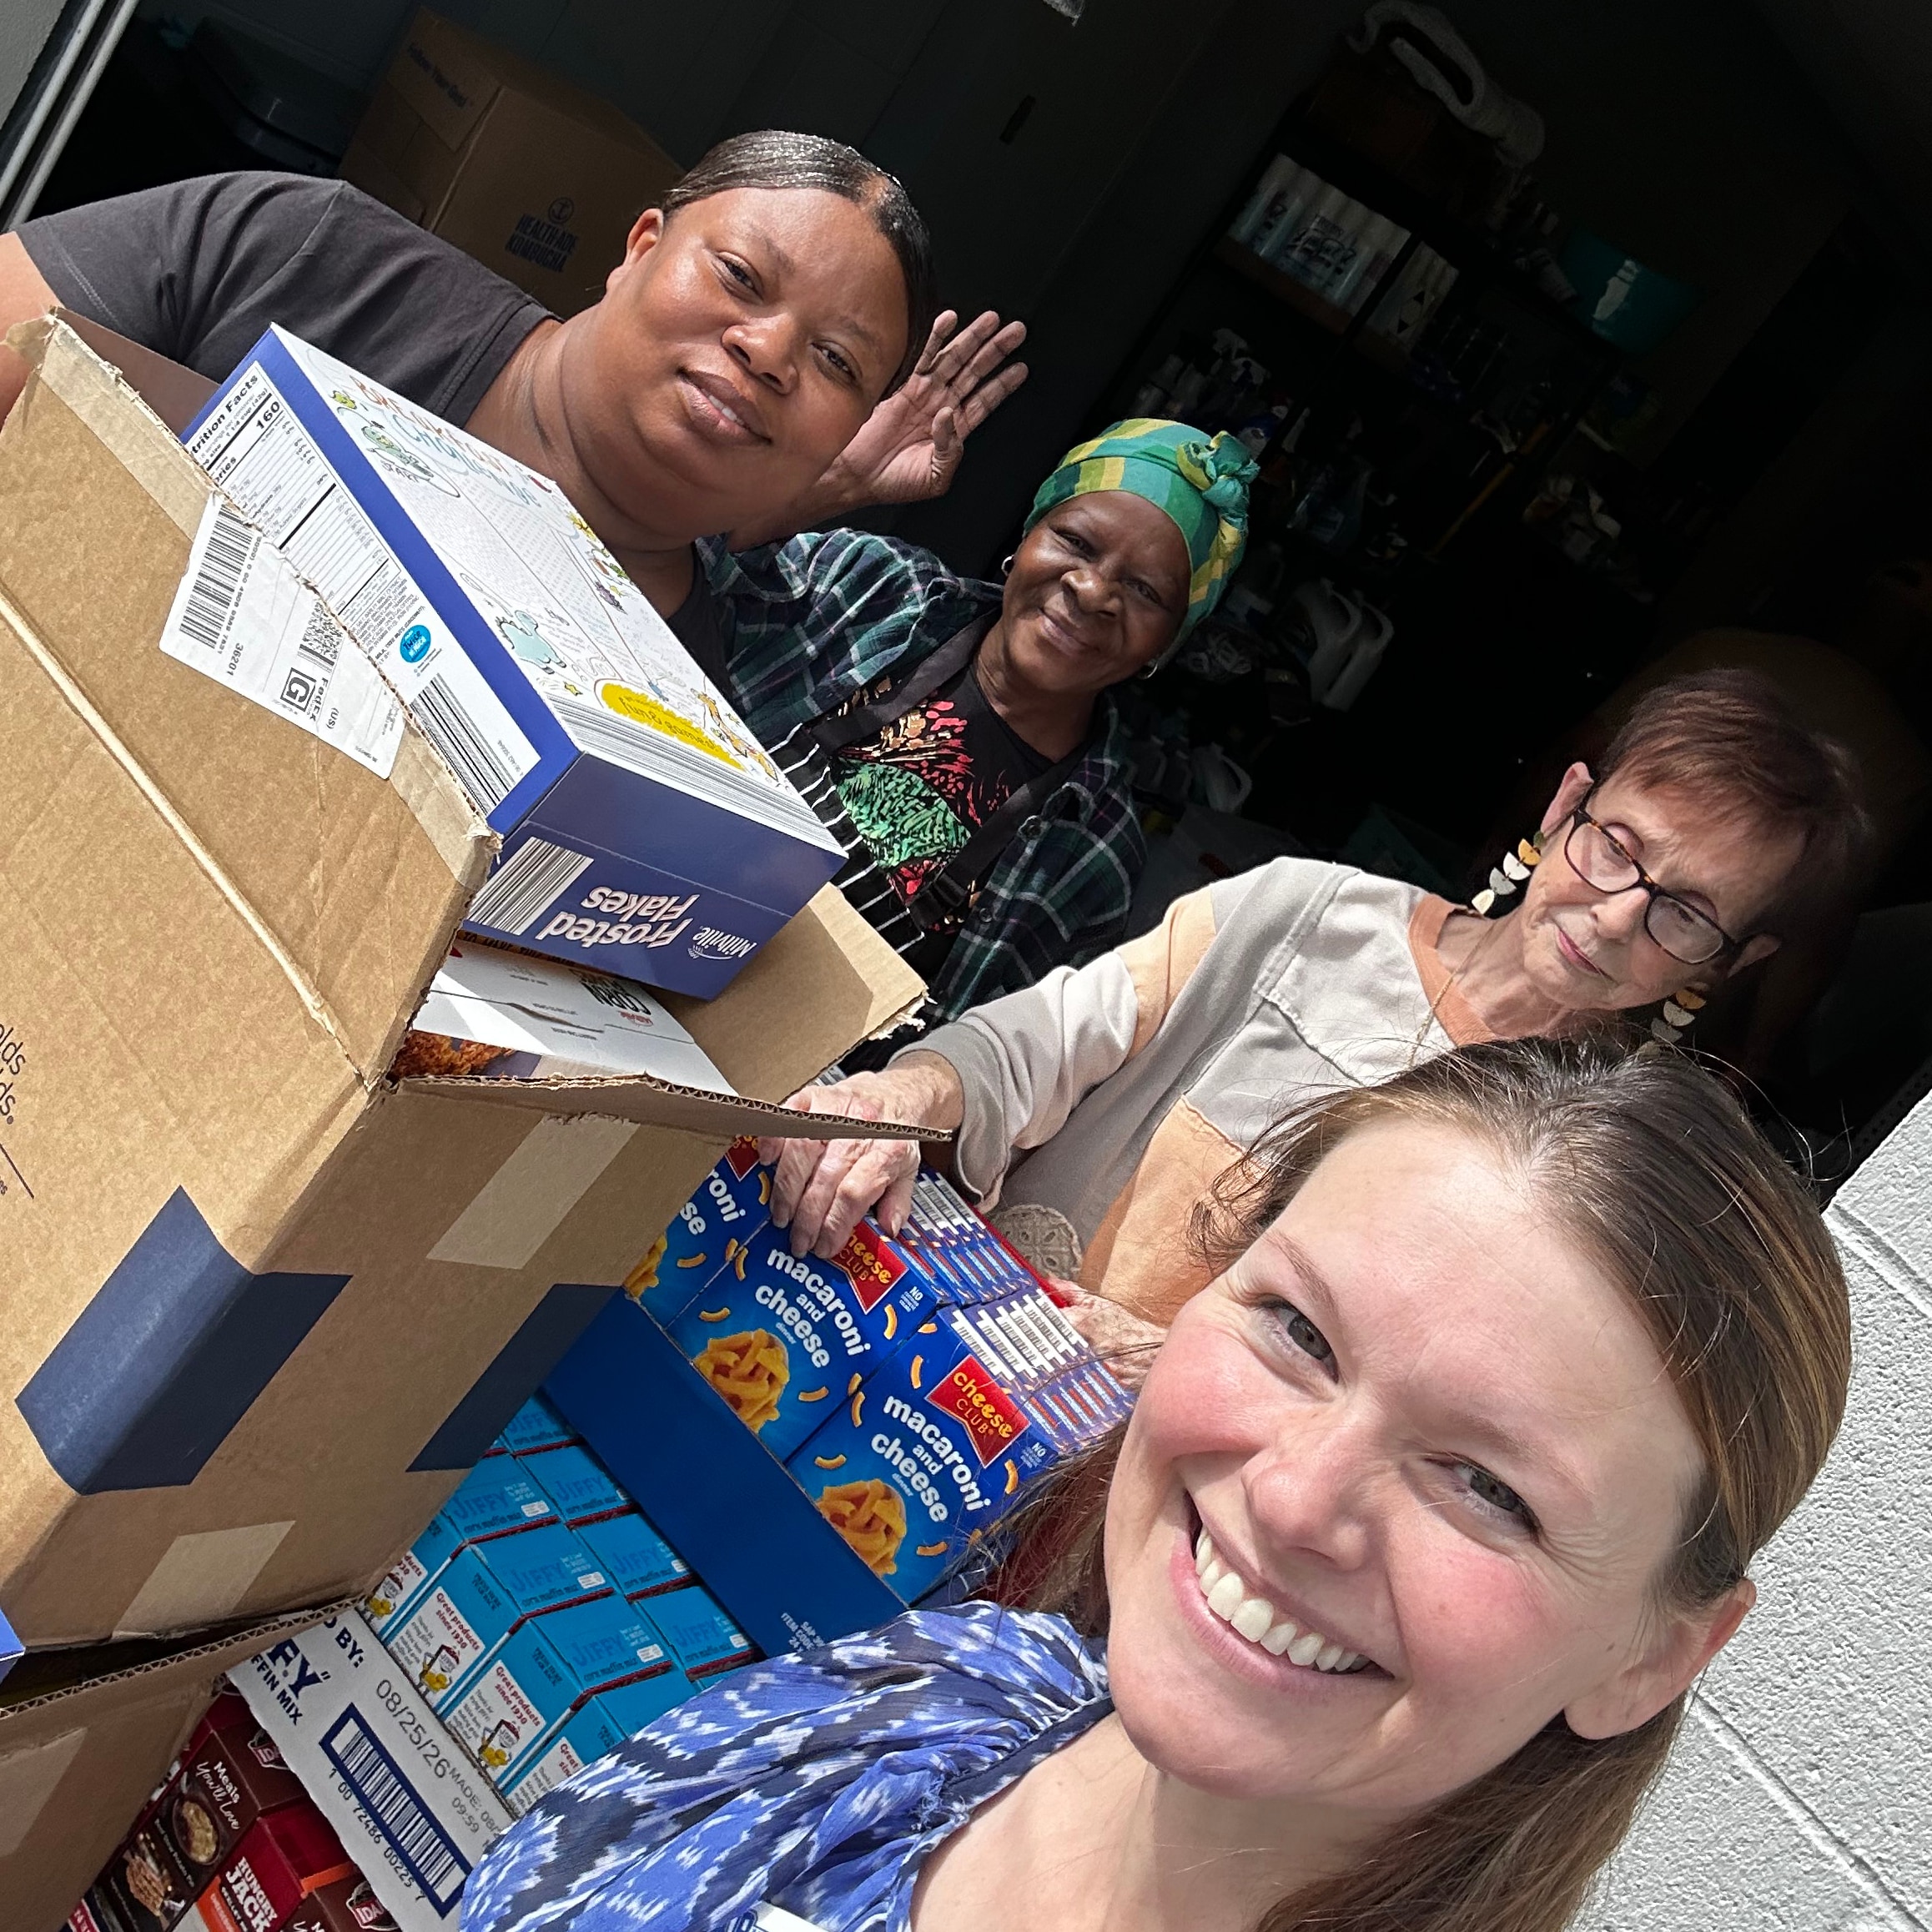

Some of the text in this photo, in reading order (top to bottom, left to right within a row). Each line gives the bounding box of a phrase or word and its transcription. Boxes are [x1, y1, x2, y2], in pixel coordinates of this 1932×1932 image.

[188, 412, 226, 456] trition
[224, 373, 259, 413] Facts
[254, 400, 282, 430] 160
[224, 642, 244, 676] 36201
[288, 677, 309, 703] G
[325, 707, 340, 729] (US)
[582, 886, 700, 923] Flakes
[535, 911, 693, 948] Frosted
[692, 927, 757, 958] Millville
[706, 1170, 747, 1223] roni
[847, 1230, 893, 1284] heese
[767, 1249, 871, 1356] macaroni
[794, 1291, 825, 1323] and
[908, 1285, 923, 1302] NO
[755, 1285, 828, 1369] cheese
[775, 1321, 796, 1345] dinner
[953, 1371, 1013, 1438] cheese
[955, 1397, 988, 1434] CLUB
[883, 1396, 992, 1512] macaroni
[912, 1442, 943, 1475] and
[1030, 1441, 1046, 1458] NO
[553, 1476, 606, 1501] JIFFY
[871, 1434, 950, 1522] cheese
[891, 1472, 913, 1497] dinner
[450, 1490, 509, 1519] JIFFY
[404, 1554, 422, 1577] ducts
[509, 1561, 566, 1591] JIFFY
[611, 1546, 661, 1574] JIFFY
[435, 1608, 454, 1630] since
[435, 1592, 480, 1650] Great products
[672, 1619, 720, 1647] JIFFY
[780, 1612, 798, 1632] ITEM
[800, 1621, 818, 1638] SAP
[335, 1627, 365, 1668] BY:
[570, 1633, 624, 1665] JIFFY
[249, 1653, 303, 1726] FFIN MIX
[494, 1667, 541, 1726] Great products
[494, 1683, 527, 1724] since 1930
[375, 1679, 449, 1779] 08/25/26
[557, 1743, 579, 1768] Great
[195, 1761, 239, 1829] You'll Love
[213, 1760, 239, 1804] Meals
[448, 1768, 482, 1810] MADE:
[451, 1797, 480, 1834] 09:59
[326, 1768, 425, 1902] 1 00 72486 00225 7
[224, 1865, 270, 1932] JACK
[237, 1858, 278, 1921] HUNGRY
